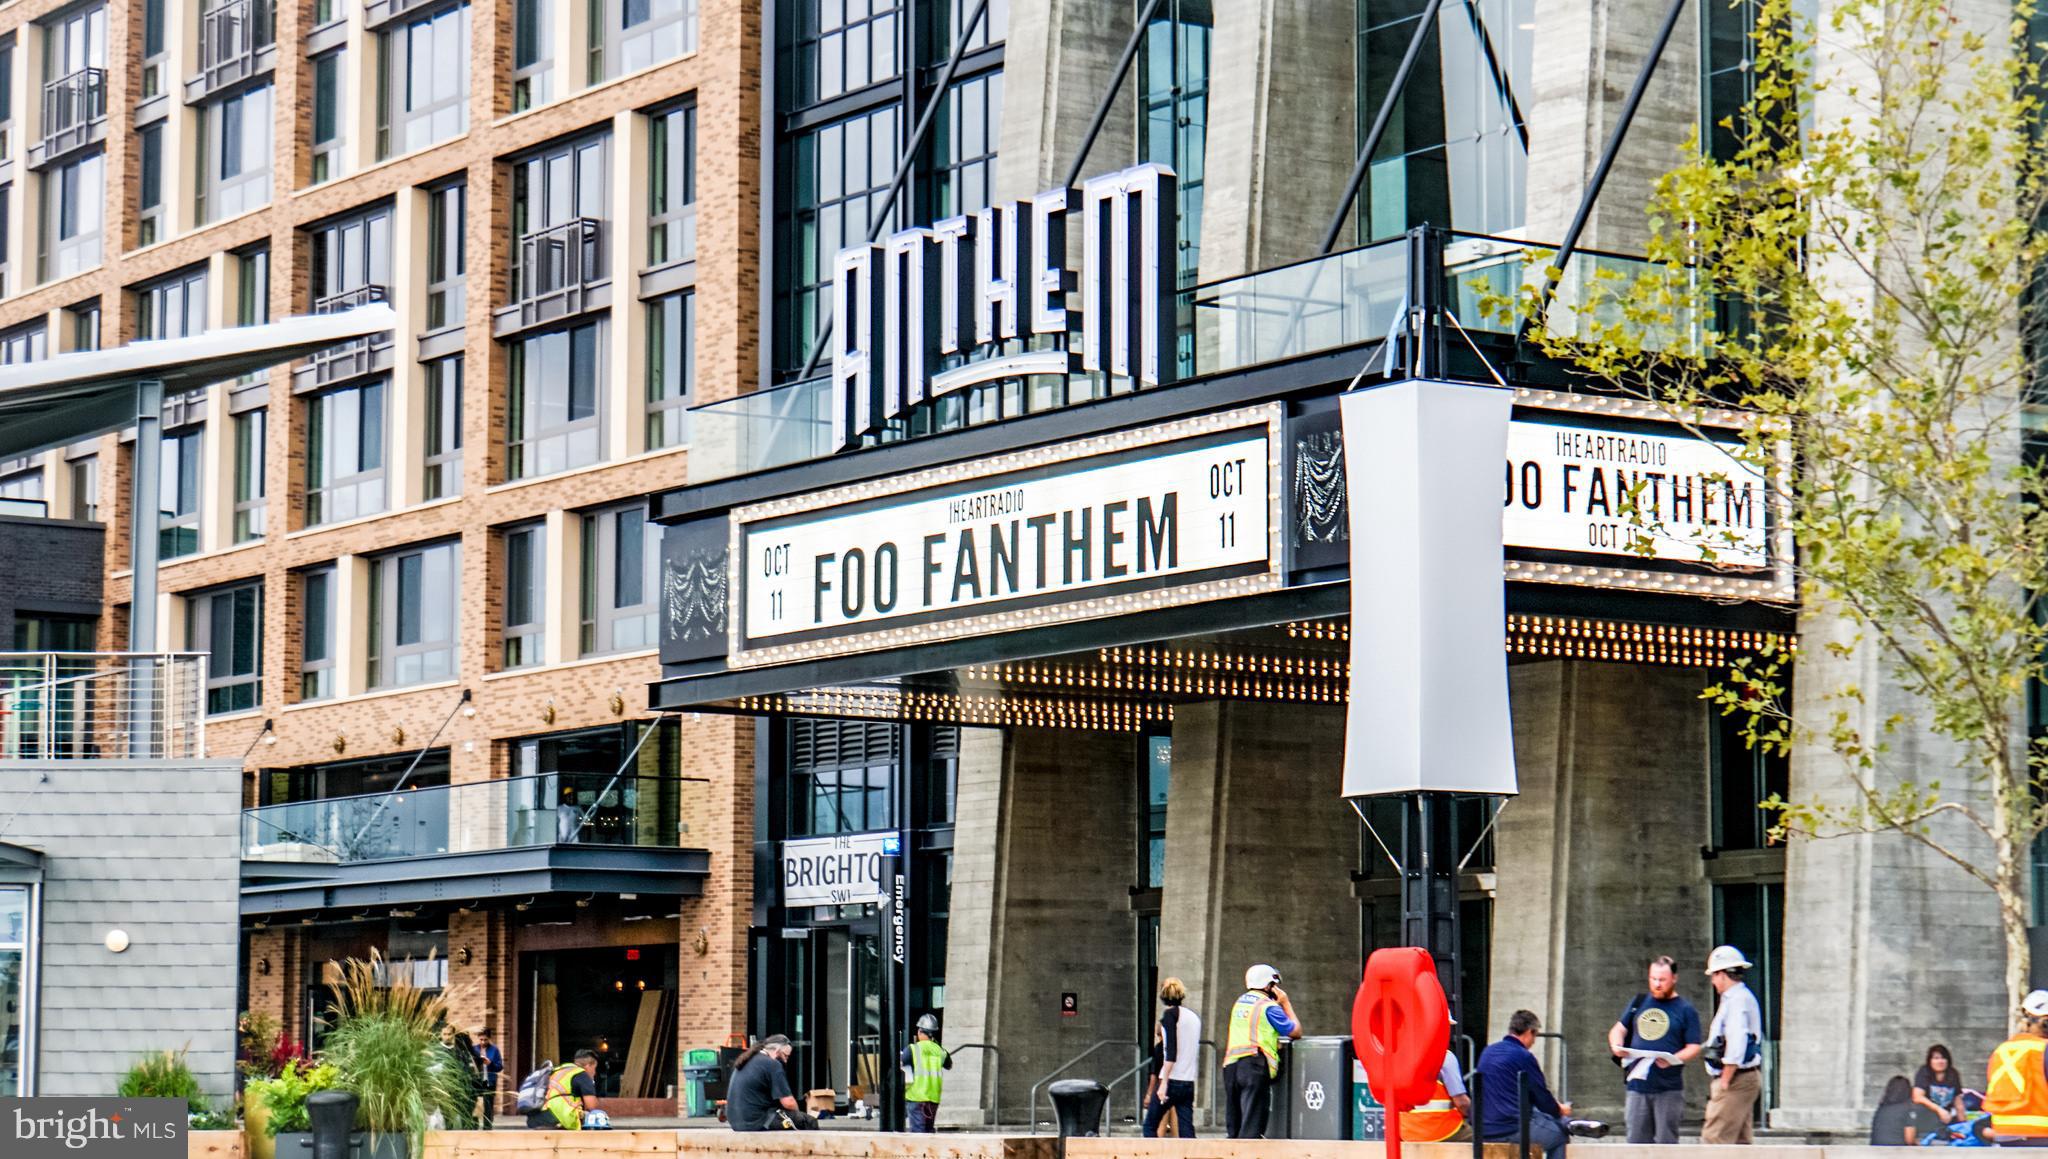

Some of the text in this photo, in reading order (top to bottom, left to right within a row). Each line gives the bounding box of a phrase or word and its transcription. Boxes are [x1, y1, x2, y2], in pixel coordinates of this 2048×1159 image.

[832, 163, 1176, 454] ANTHEM
[1556, 431, 1667, 466] IHEARTRADIO
[1210, 458, 1246, 499] OCT
[1563, 464, 1754, 529] FANTHEM
[949, 488, 1025, 524] IHEARTRADIO
[1219, 511, 1236, 549] 11
[1589, 522, 1618, 549] OCT
[764, 543, 791, 578] OCT
[814, 491, 1178, 624] FOO FANTHEM
[771, 588, 783, 621] 11
[834, 836, 851, 849] THE
[786, 851, 880, 887] BRIGHTO
[893, 874, 905, 964] Emergency
